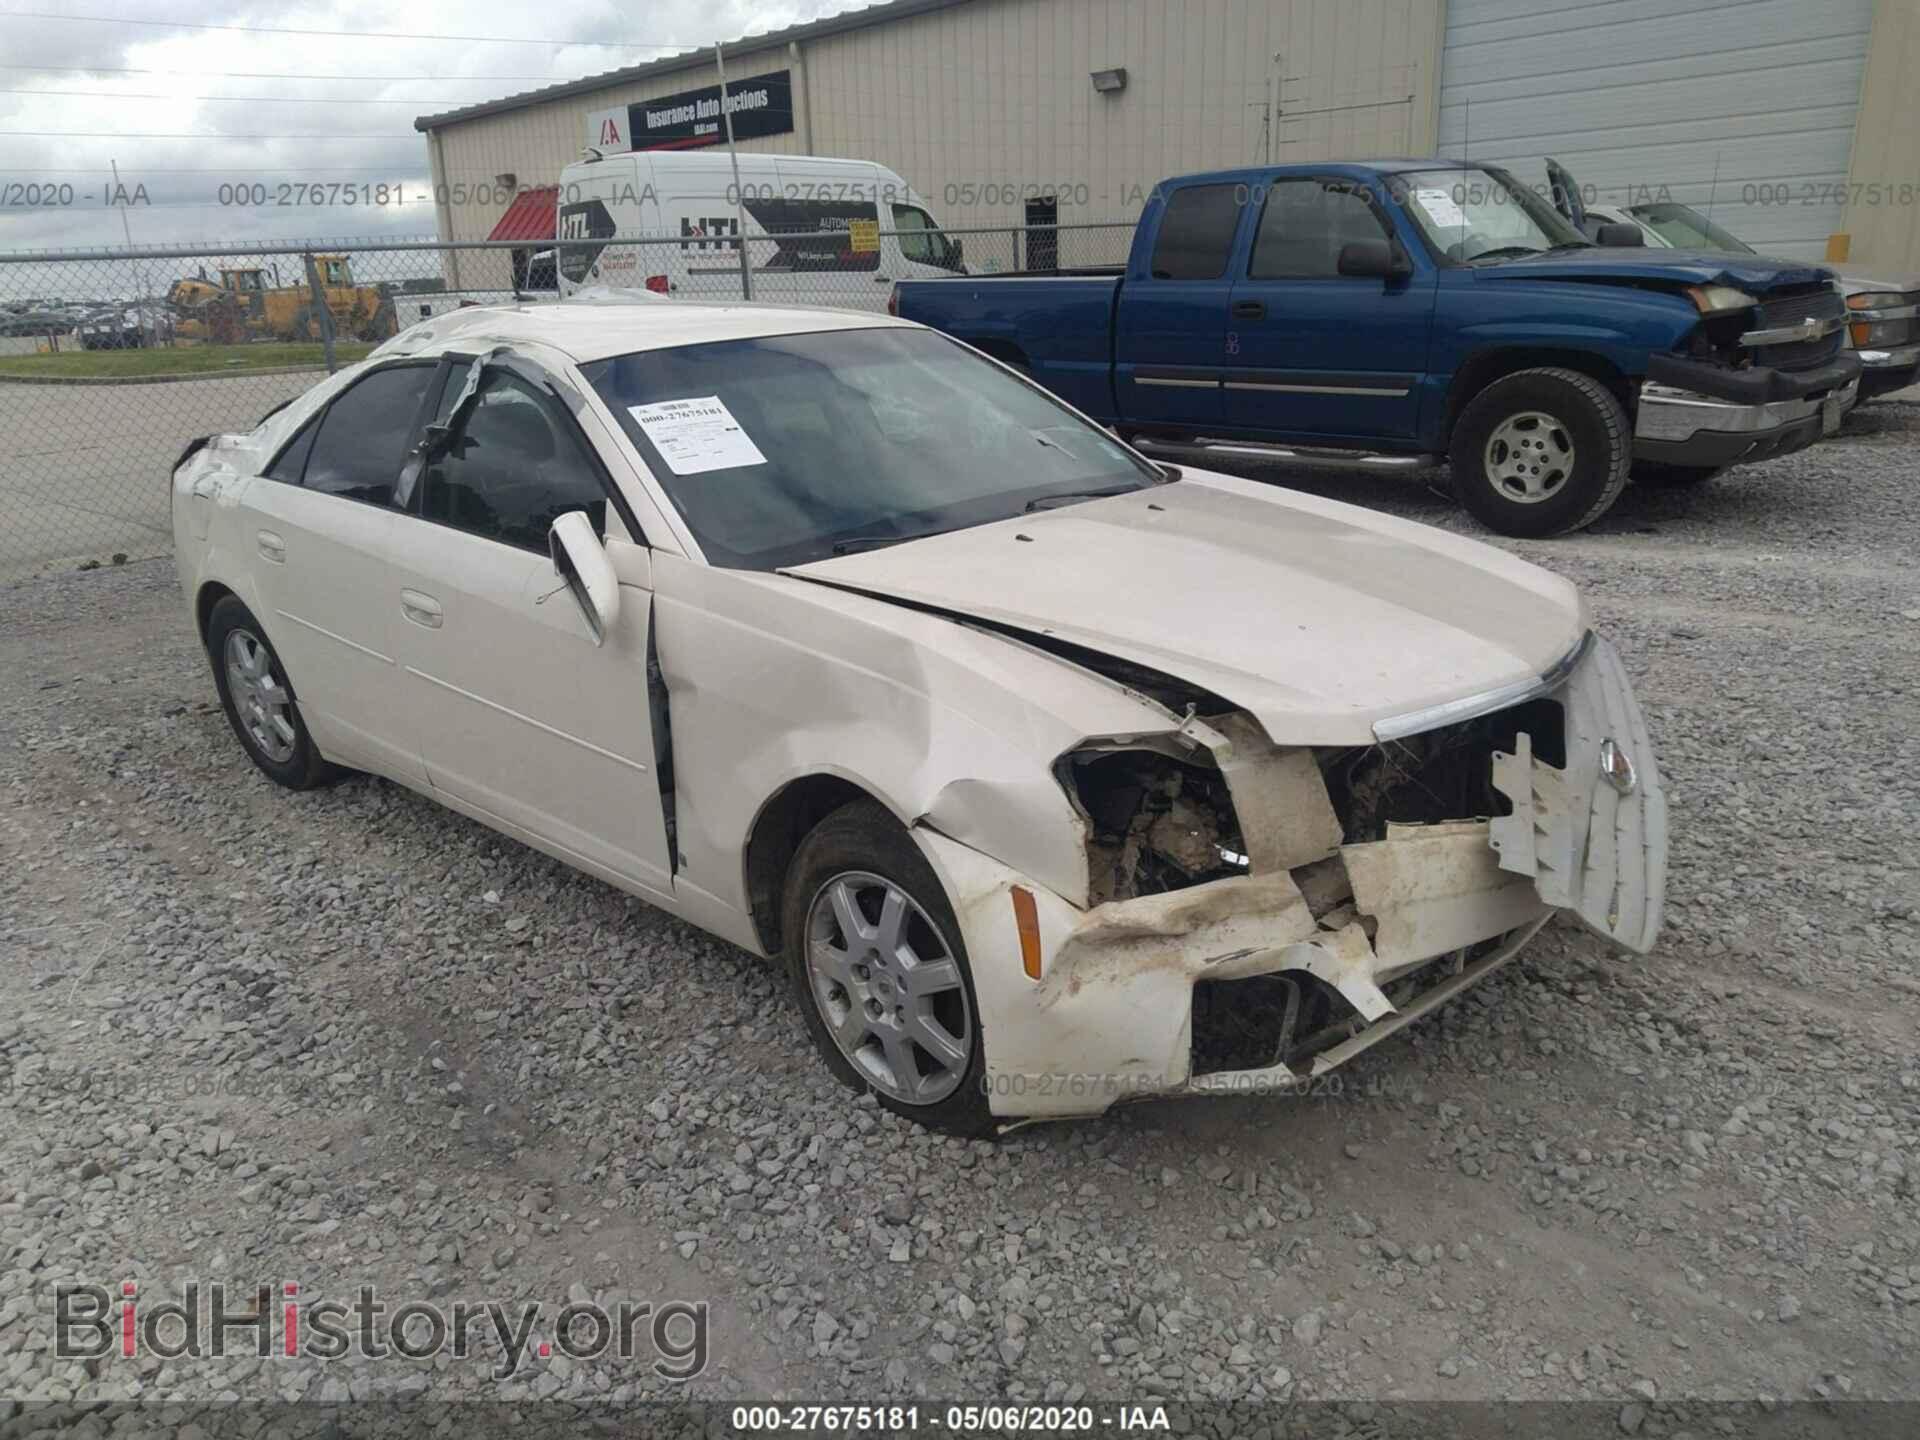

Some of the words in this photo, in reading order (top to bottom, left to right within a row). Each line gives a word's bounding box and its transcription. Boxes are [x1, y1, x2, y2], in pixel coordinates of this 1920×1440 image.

[646, 105, 696, 129] Insurance
[696, 98, 720, 119] Auto
[641, 407, 723, 424] 000-27675181
